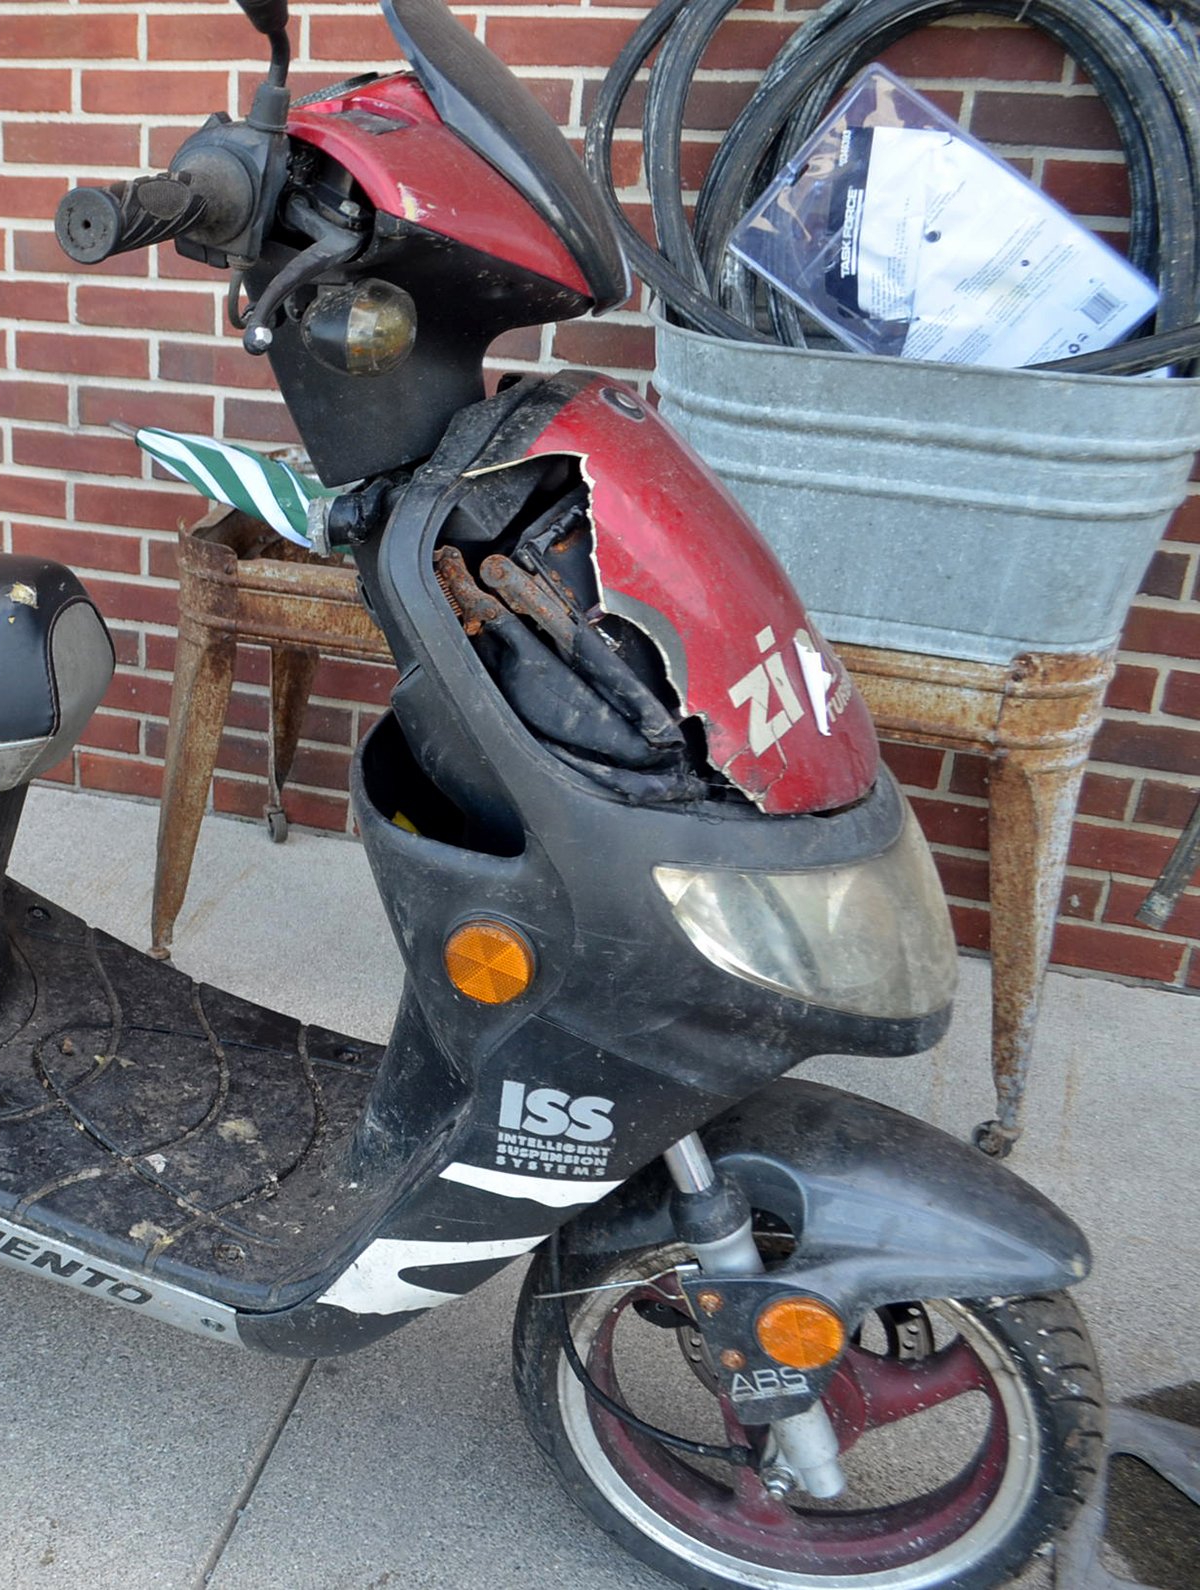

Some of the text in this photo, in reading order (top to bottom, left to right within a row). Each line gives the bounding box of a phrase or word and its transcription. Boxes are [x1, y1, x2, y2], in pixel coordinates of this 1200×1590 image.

[840, 187, 858, 279] TASK FORCE
[498, 1080, 615, 1142] ISS
[496, 1144, 608, 1167] SUSPENSION
[497, 1132, 611, 1157] INTELLIGENT
[495, 1155, 606, 1176] SYSTEMS
[731, 1366, 808, 1396] ABS
